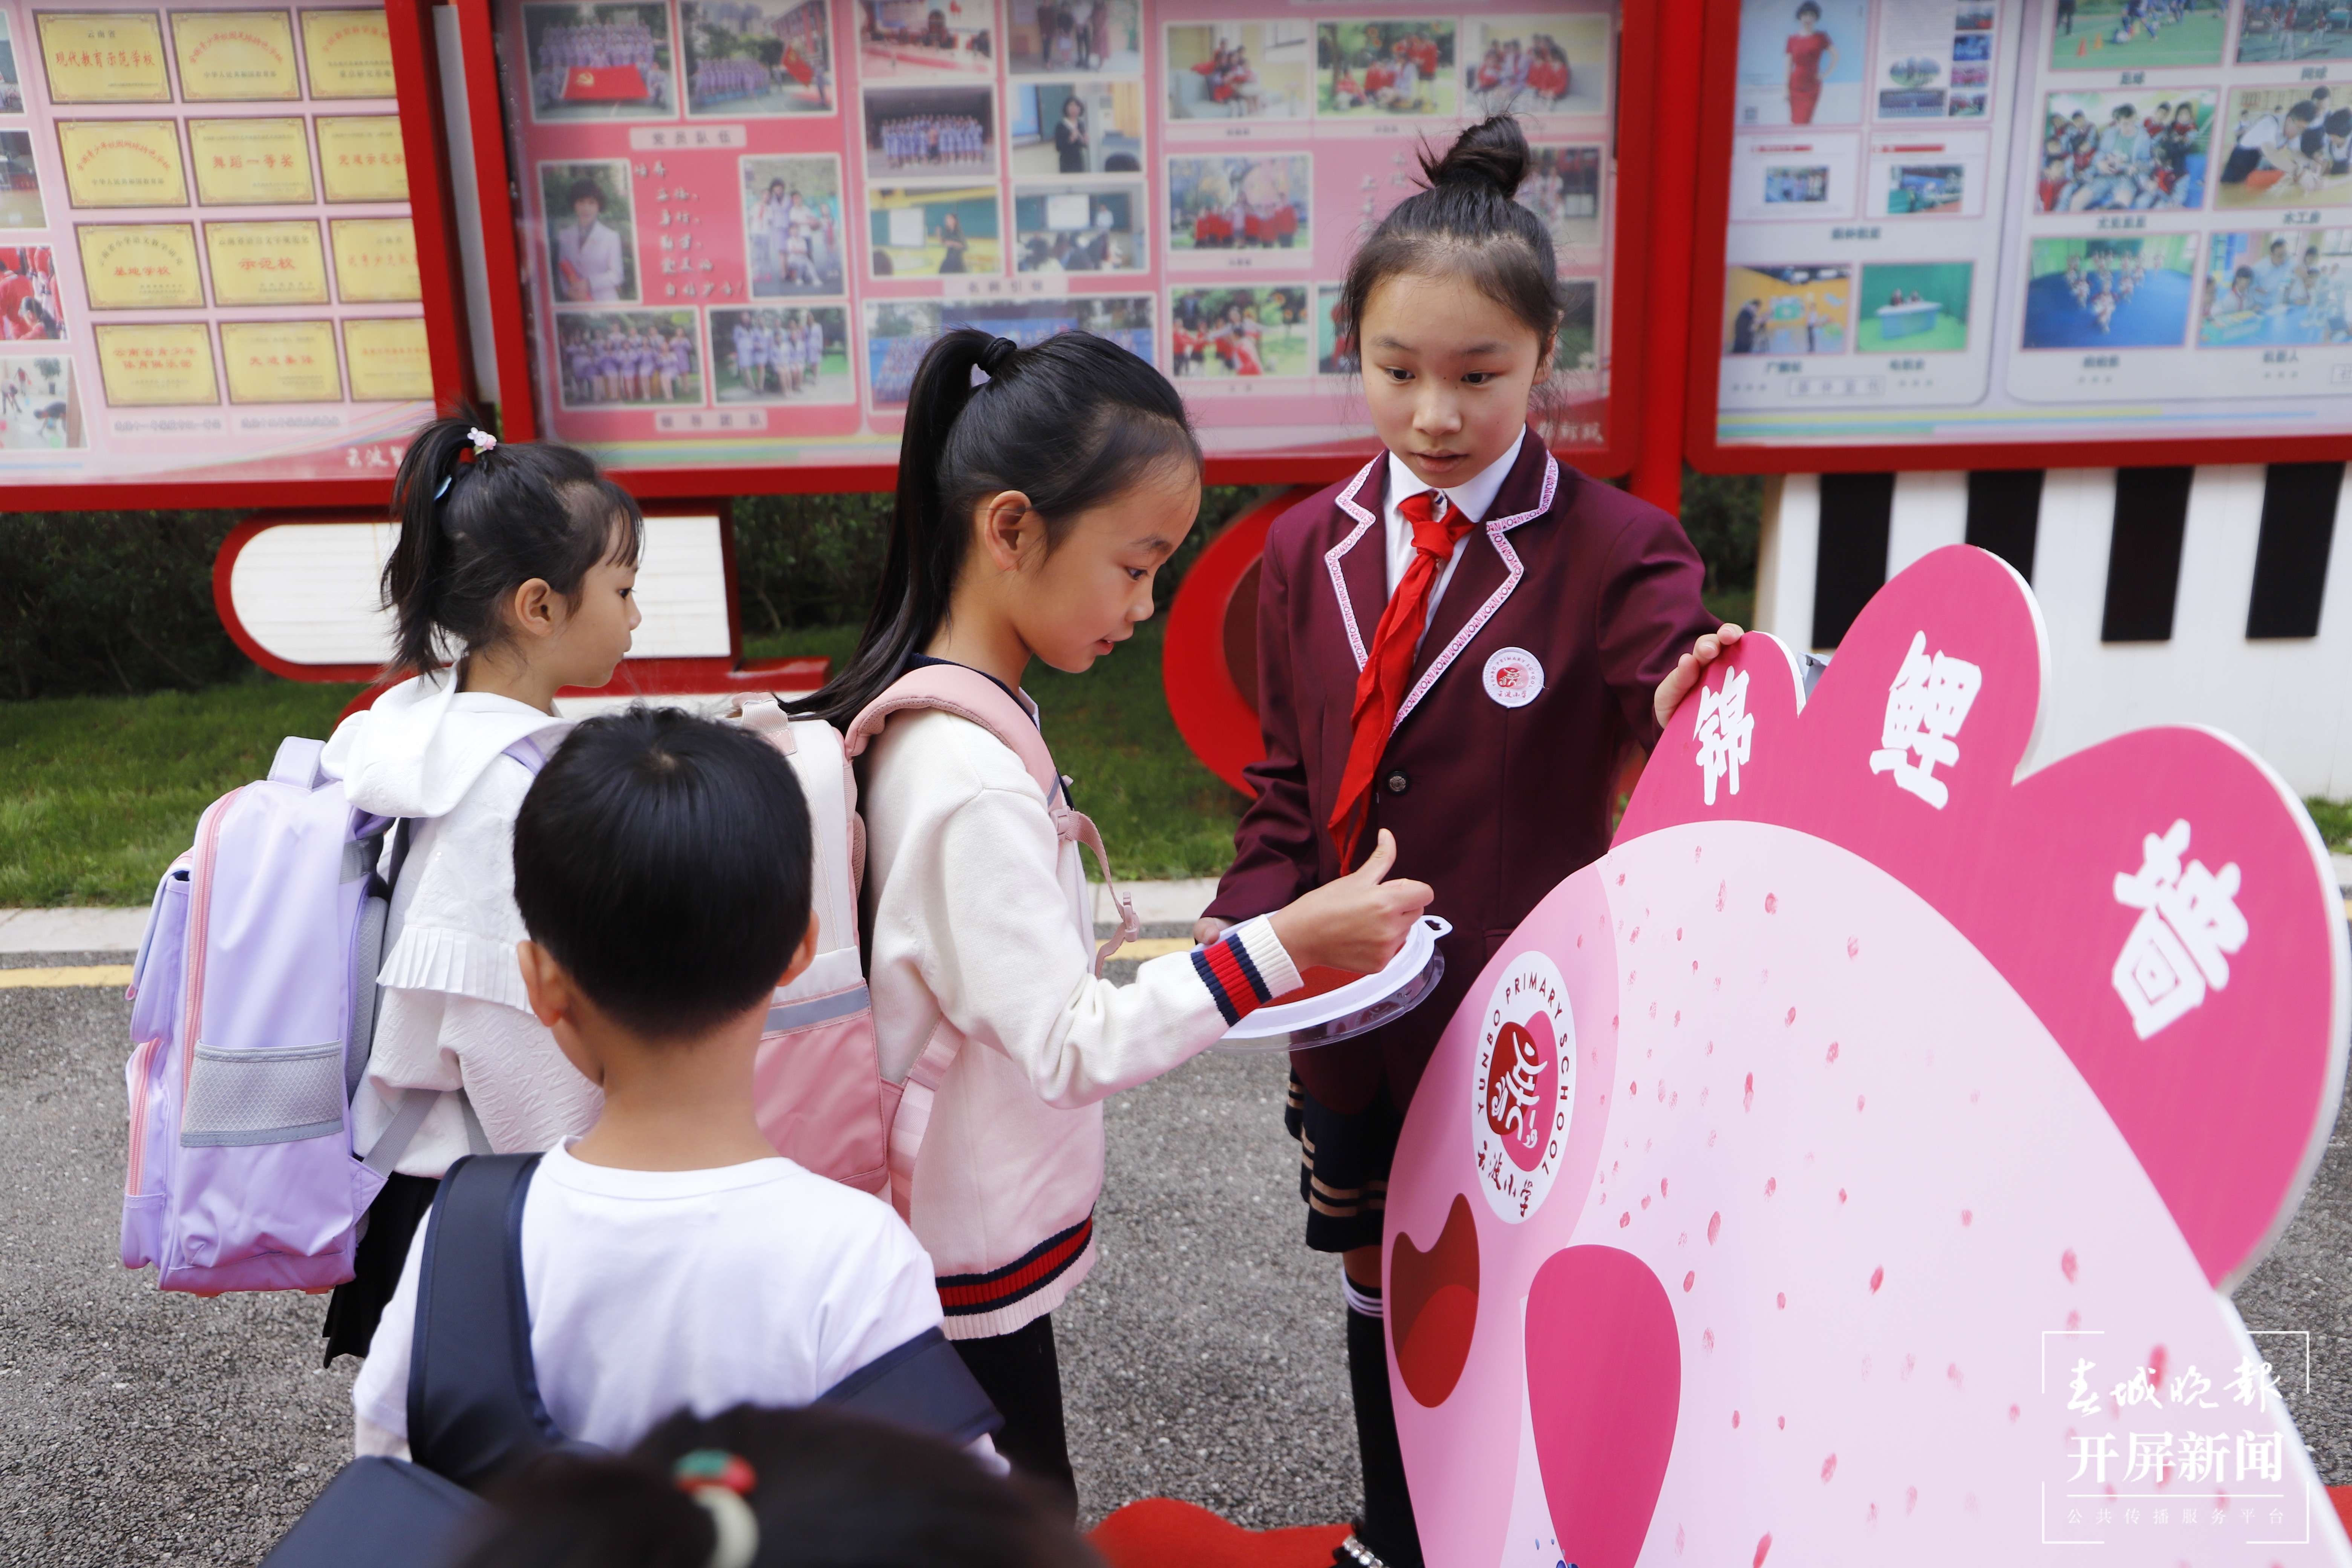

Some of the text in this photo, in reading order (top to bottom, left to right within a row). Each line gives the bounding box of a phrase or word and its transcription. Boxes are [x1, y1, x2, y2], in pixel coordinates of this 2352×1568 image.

[87, 30, 115, 38] 云南省
[55, 49, 155, 67] 现代教育示范学校
[213, 154, 293, 169] 舞蹈一等奖
[238, 257, 296, 270] 示范校
[1527, 664, 1536, 687] SCHOOL
[1478, 971, 1570, 1175] YUNBO PRIMARY SCHOOL
[1478, 1140, 1533, 1217] 云波小学
